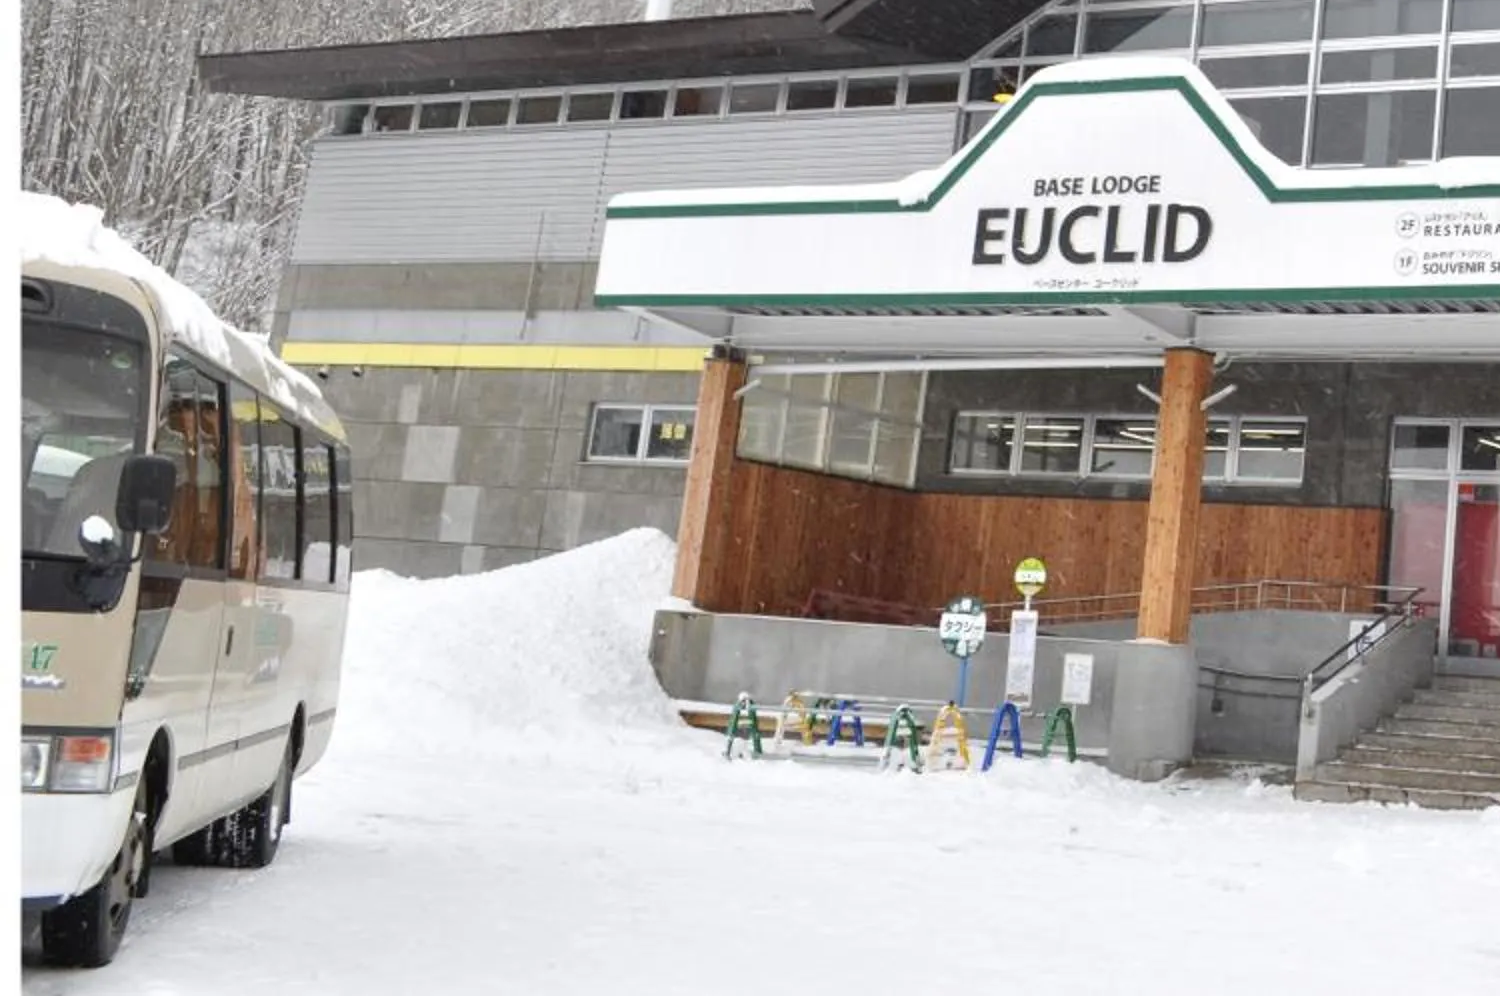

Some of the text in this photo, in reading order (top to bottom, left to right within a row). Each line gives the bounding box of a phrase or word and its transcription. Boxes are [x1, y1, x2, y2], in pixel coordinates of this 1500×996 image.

[1033, 175, 1161, 197] BASE LODGE
[972, 204, 1213, 265] EUCLID
[1423, 261, 1485, 275] SOUVENIR
